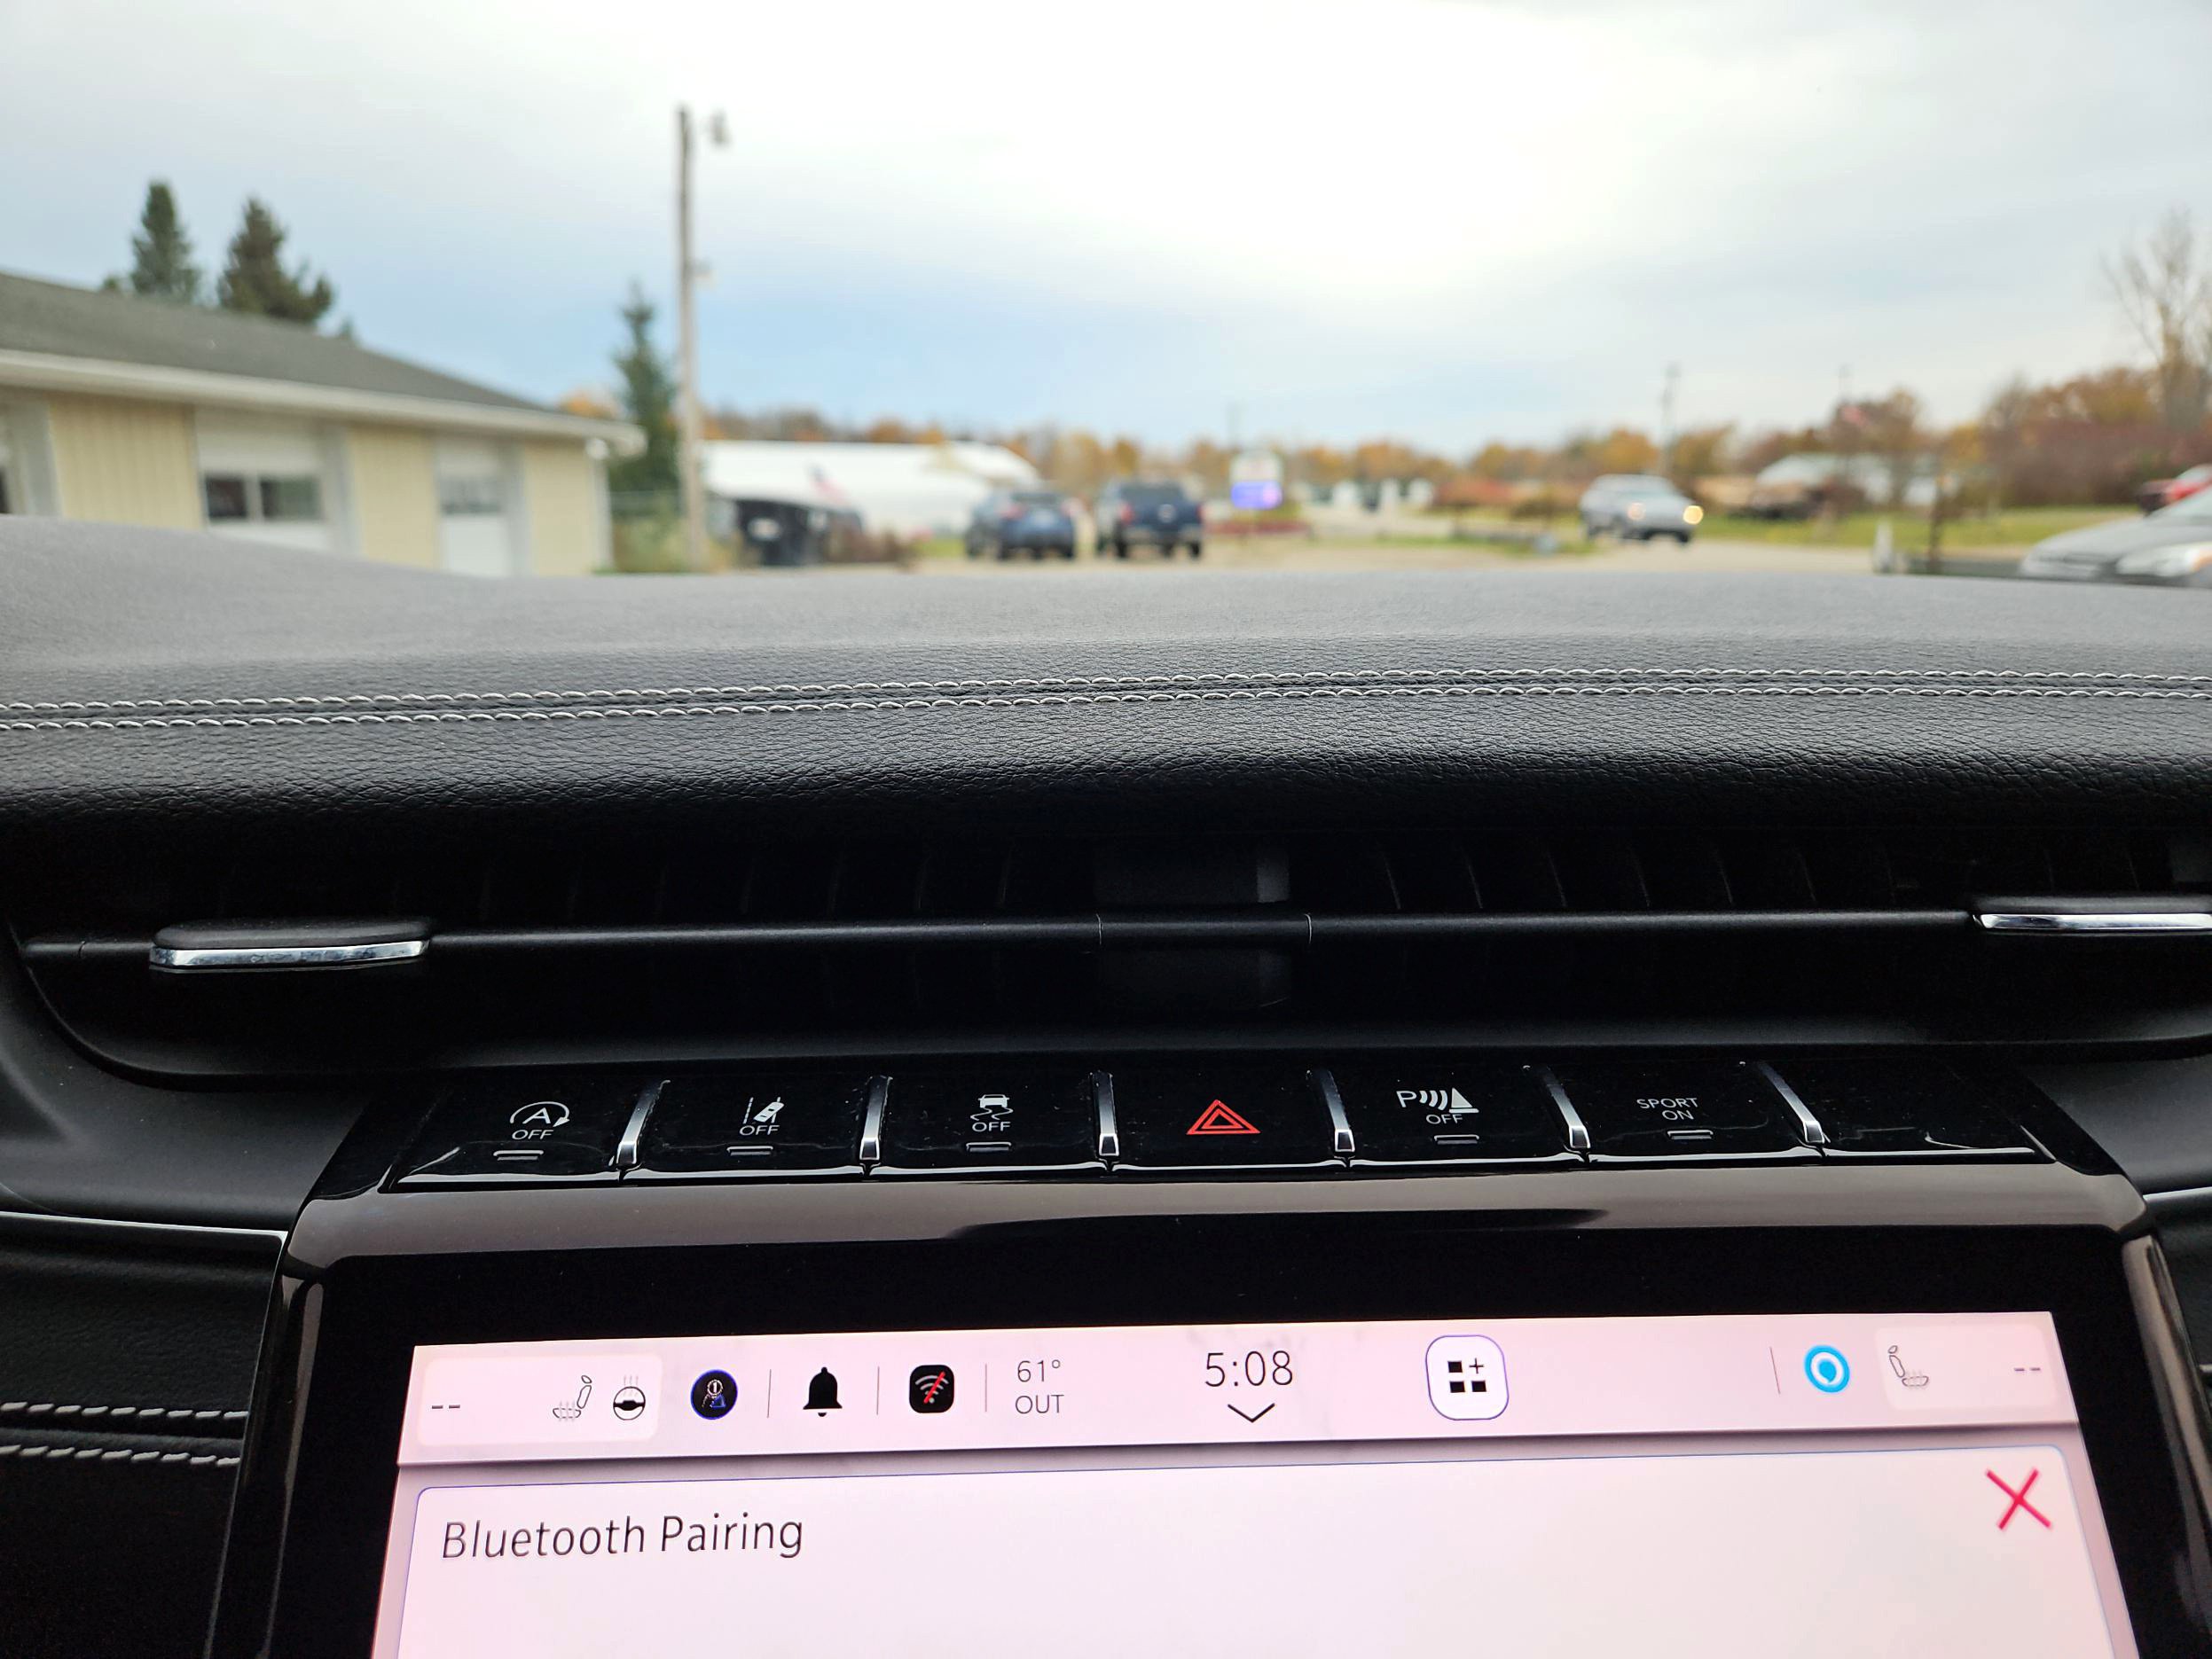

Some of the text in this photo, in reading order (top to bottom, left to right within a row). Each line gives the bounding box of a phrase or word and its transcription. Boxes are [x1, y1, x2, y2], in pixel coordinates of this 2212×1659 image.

[1636, 1097, 1698, 1109] SPORT
[522, 1107, 552, 1125] A
[1425, 1114, 1463, 1125] OFF
[1661, 1109, 1695, 1121] ON
[739, 1124, 780, 1136] OFF
[971, 1121, 1012, 1132] OFF
[511, 1129, 554, 1140] OFF
[1204, 1350, 1294, 1388] 5:08
[1015, 1394, 1065, 1415] OUT
[442, 1511, 804, 1560] Bluetooth Pairing
